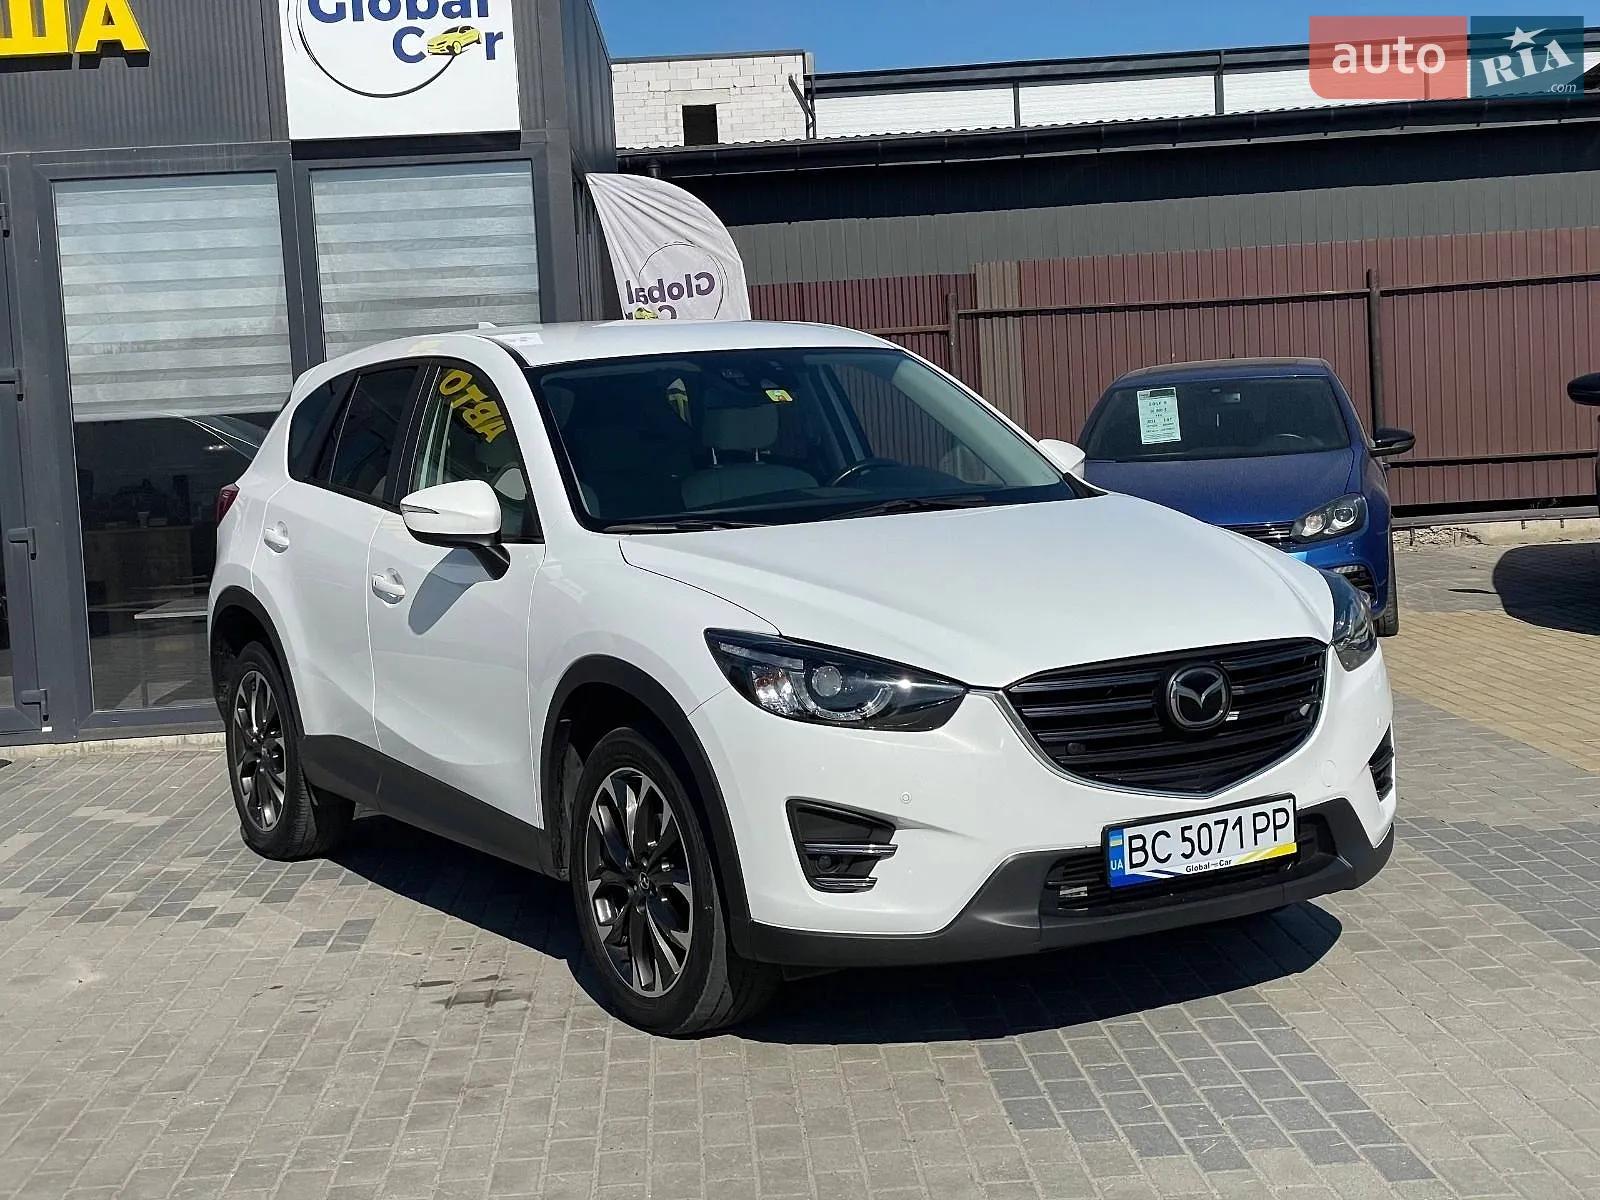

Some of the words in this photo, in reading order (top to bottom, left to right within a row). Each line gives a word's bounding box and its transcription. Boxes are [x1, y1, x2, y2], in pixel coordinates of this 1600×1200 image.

[1127, 830, 1173, 870] BC
[1180, 815, 1244, 860] 5071
[1252, 807, 1290, 846] PP
[1110, 861, 1124, 871] UA
[1185, 861, 1211, 873] Global
[1218, 858, 1233, 868] Car
